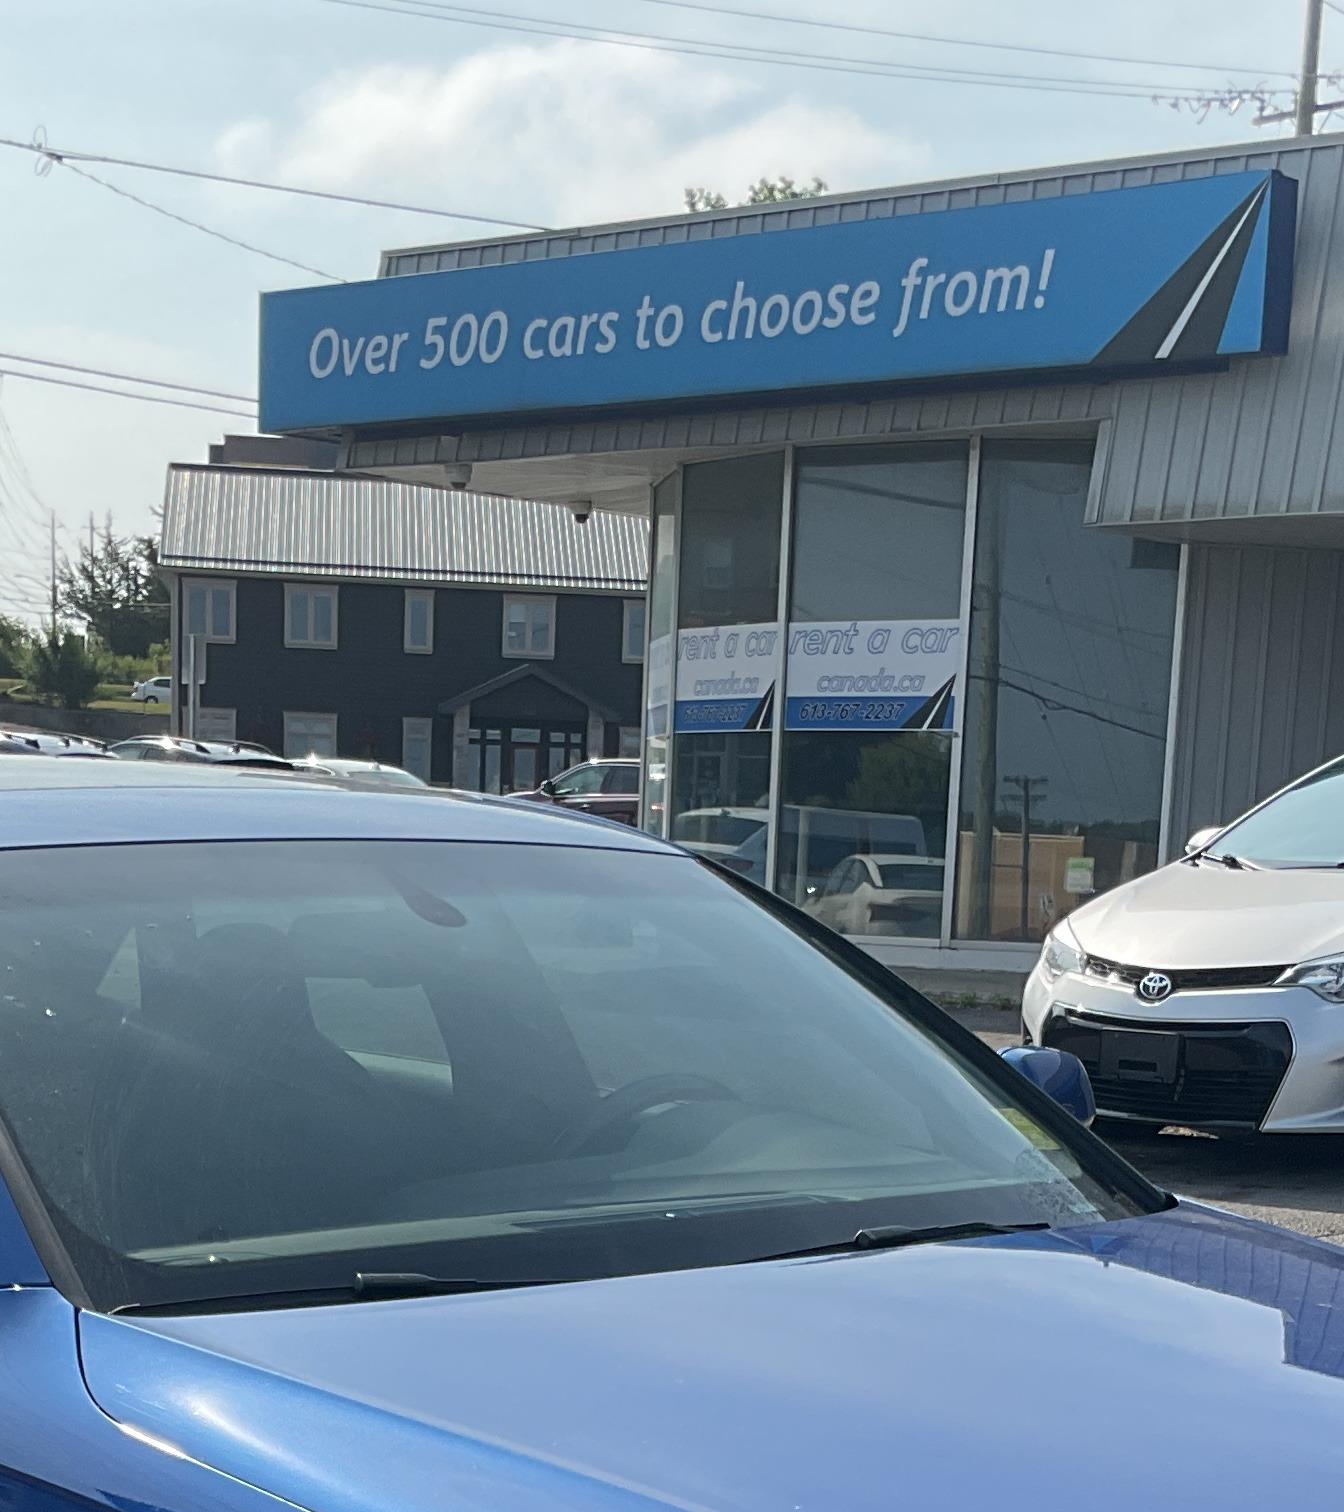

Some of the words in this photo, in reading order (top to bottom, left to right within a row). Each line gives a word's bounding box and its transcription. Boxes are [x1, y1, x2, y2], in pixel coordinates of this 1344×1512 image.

[309, 328, 409, 379] Over
[419, 311, 509, 370] 500
[523, 311, 619, 360] cars
[636, 295, 684, 350] to
[701, 281, 880, 344] choose
[892, 248, 1056, 338] from!
[678, 628, 720, 661] rent
[725, 632, 739, 658] a
[745, 631, 778, 657] car
[789, 622, 860, 656] rent
[867, 629, 892, 655] a
[901, 627, 960, 655] car
[816, 667, 926, 693] canada.ca
[800, 702, 905, 722] 613-767-2237
